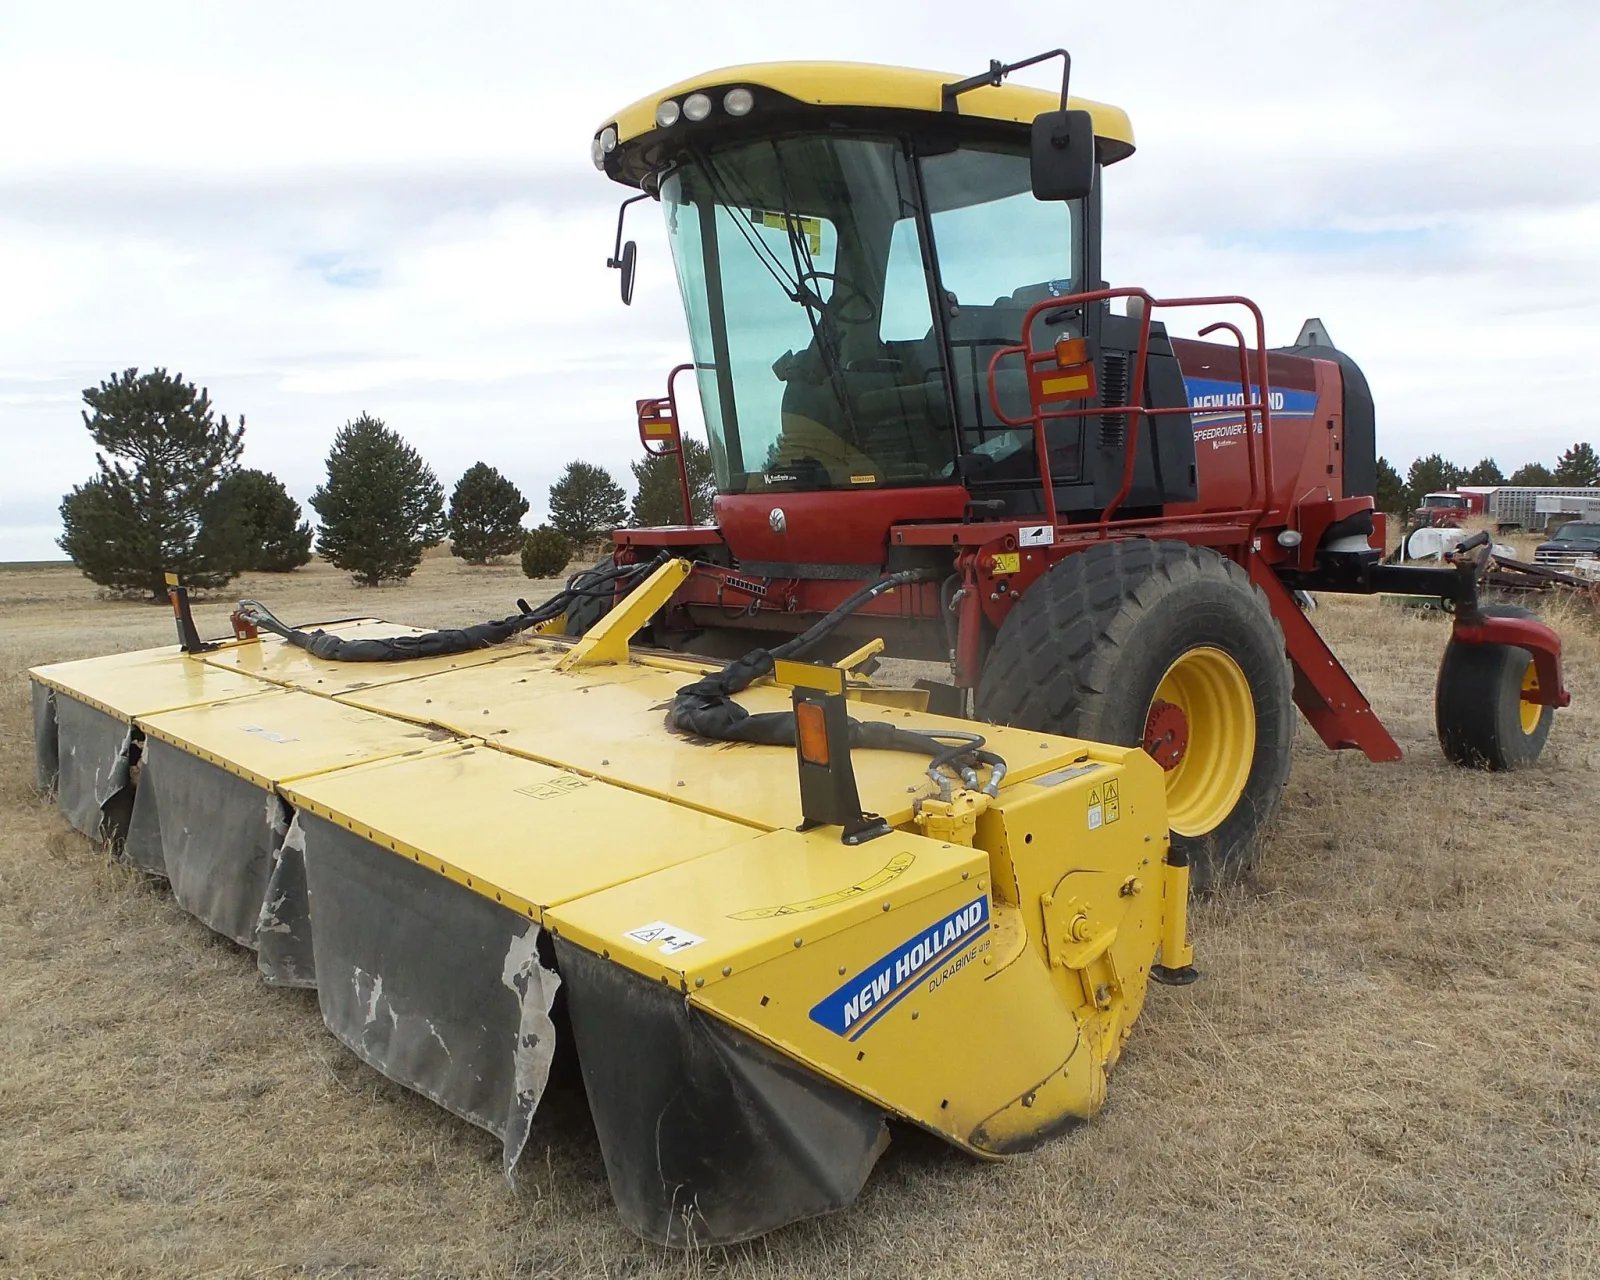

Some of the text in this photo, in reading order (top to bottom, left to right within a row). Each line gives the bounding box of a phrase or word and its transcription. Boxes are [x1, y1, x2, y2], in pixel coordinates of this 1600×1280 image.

[1193, 394, 1224, 416] NEW
[1193, 424, 1243, 442] SPEEDROWER
[844, 901, 982, 1028] NEW HOLLAND
[929, 946, 977, 993] DURABINE
